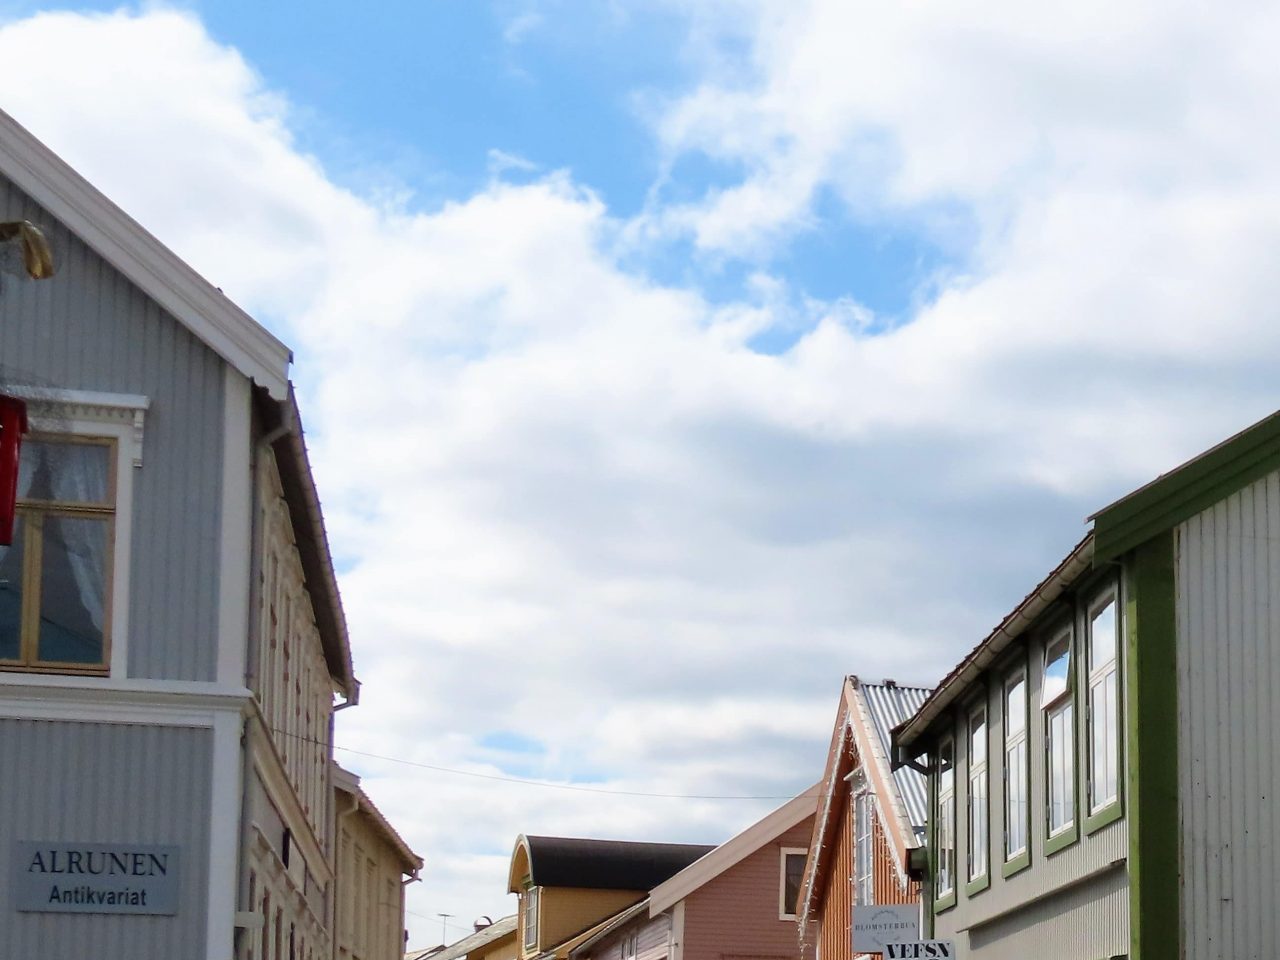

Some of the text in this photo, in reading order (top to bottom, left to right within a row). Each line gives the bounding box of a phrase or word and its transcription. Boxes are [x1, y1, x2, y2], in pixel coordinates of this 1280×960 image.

[28, 850, 168, 876] ALRUNEN
[49, 885, 147, 906] Antikvariat
[886, 942, 950, 959] VEFSN
